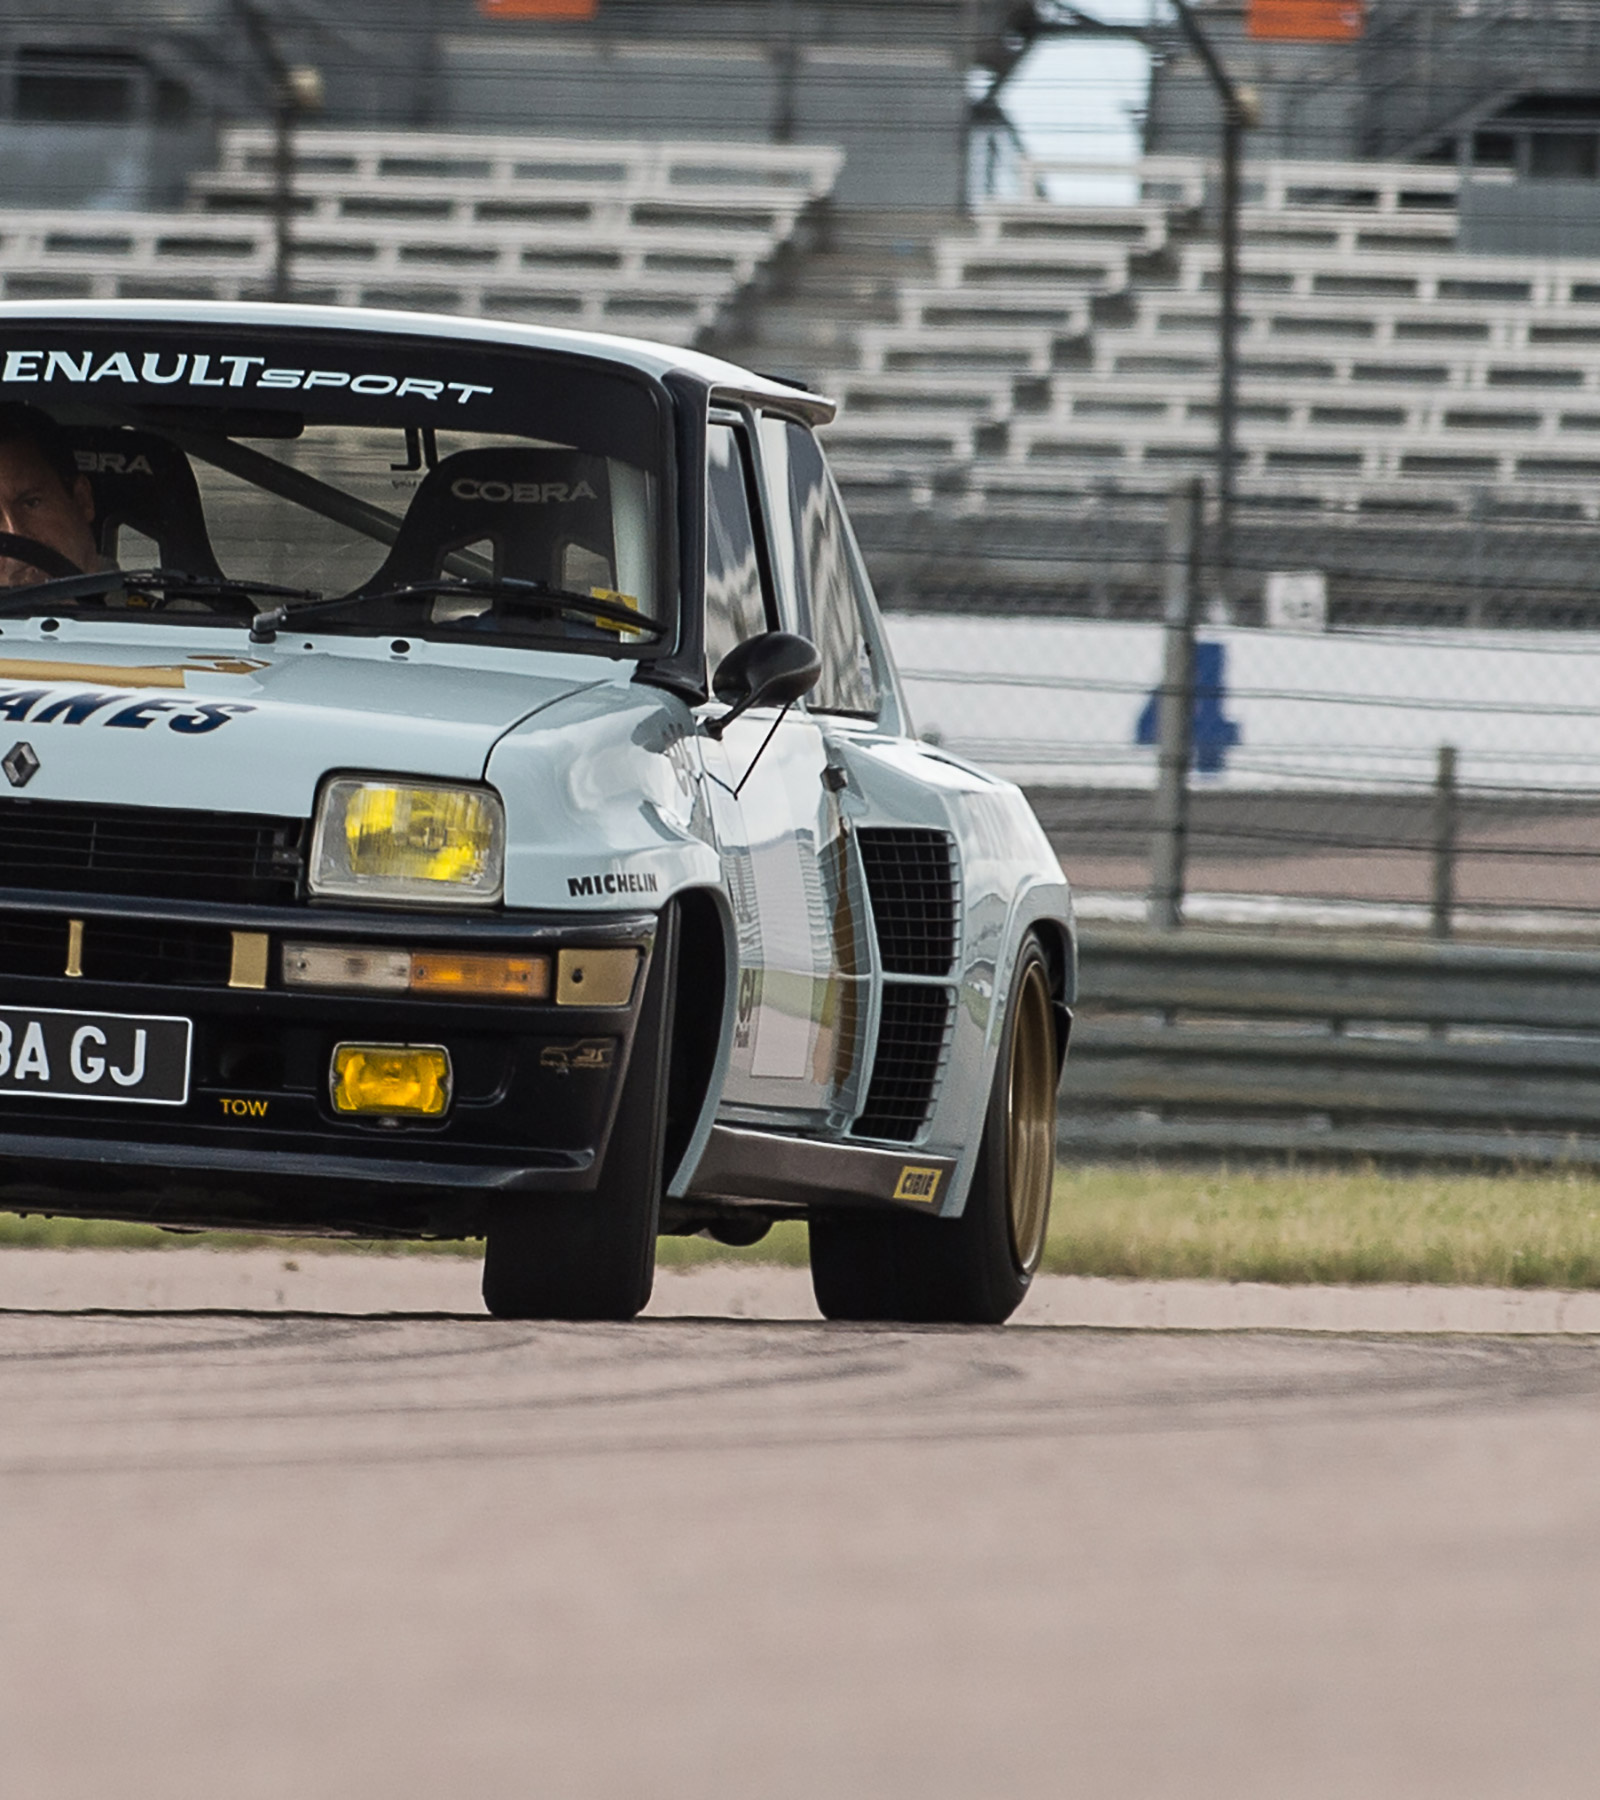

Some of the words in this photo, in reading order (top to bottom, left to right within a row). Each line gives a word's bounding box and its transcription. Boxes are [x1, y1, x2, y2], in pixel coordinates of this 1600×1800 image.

[73, 450, 154, 475] BRA
[451, 480, 598, 503] COBRA
[566, 874, 658, 897] MICHELIN
[70, 1025, 146, 1086] GJ
[219, 1099, 269, 1116] TOW
